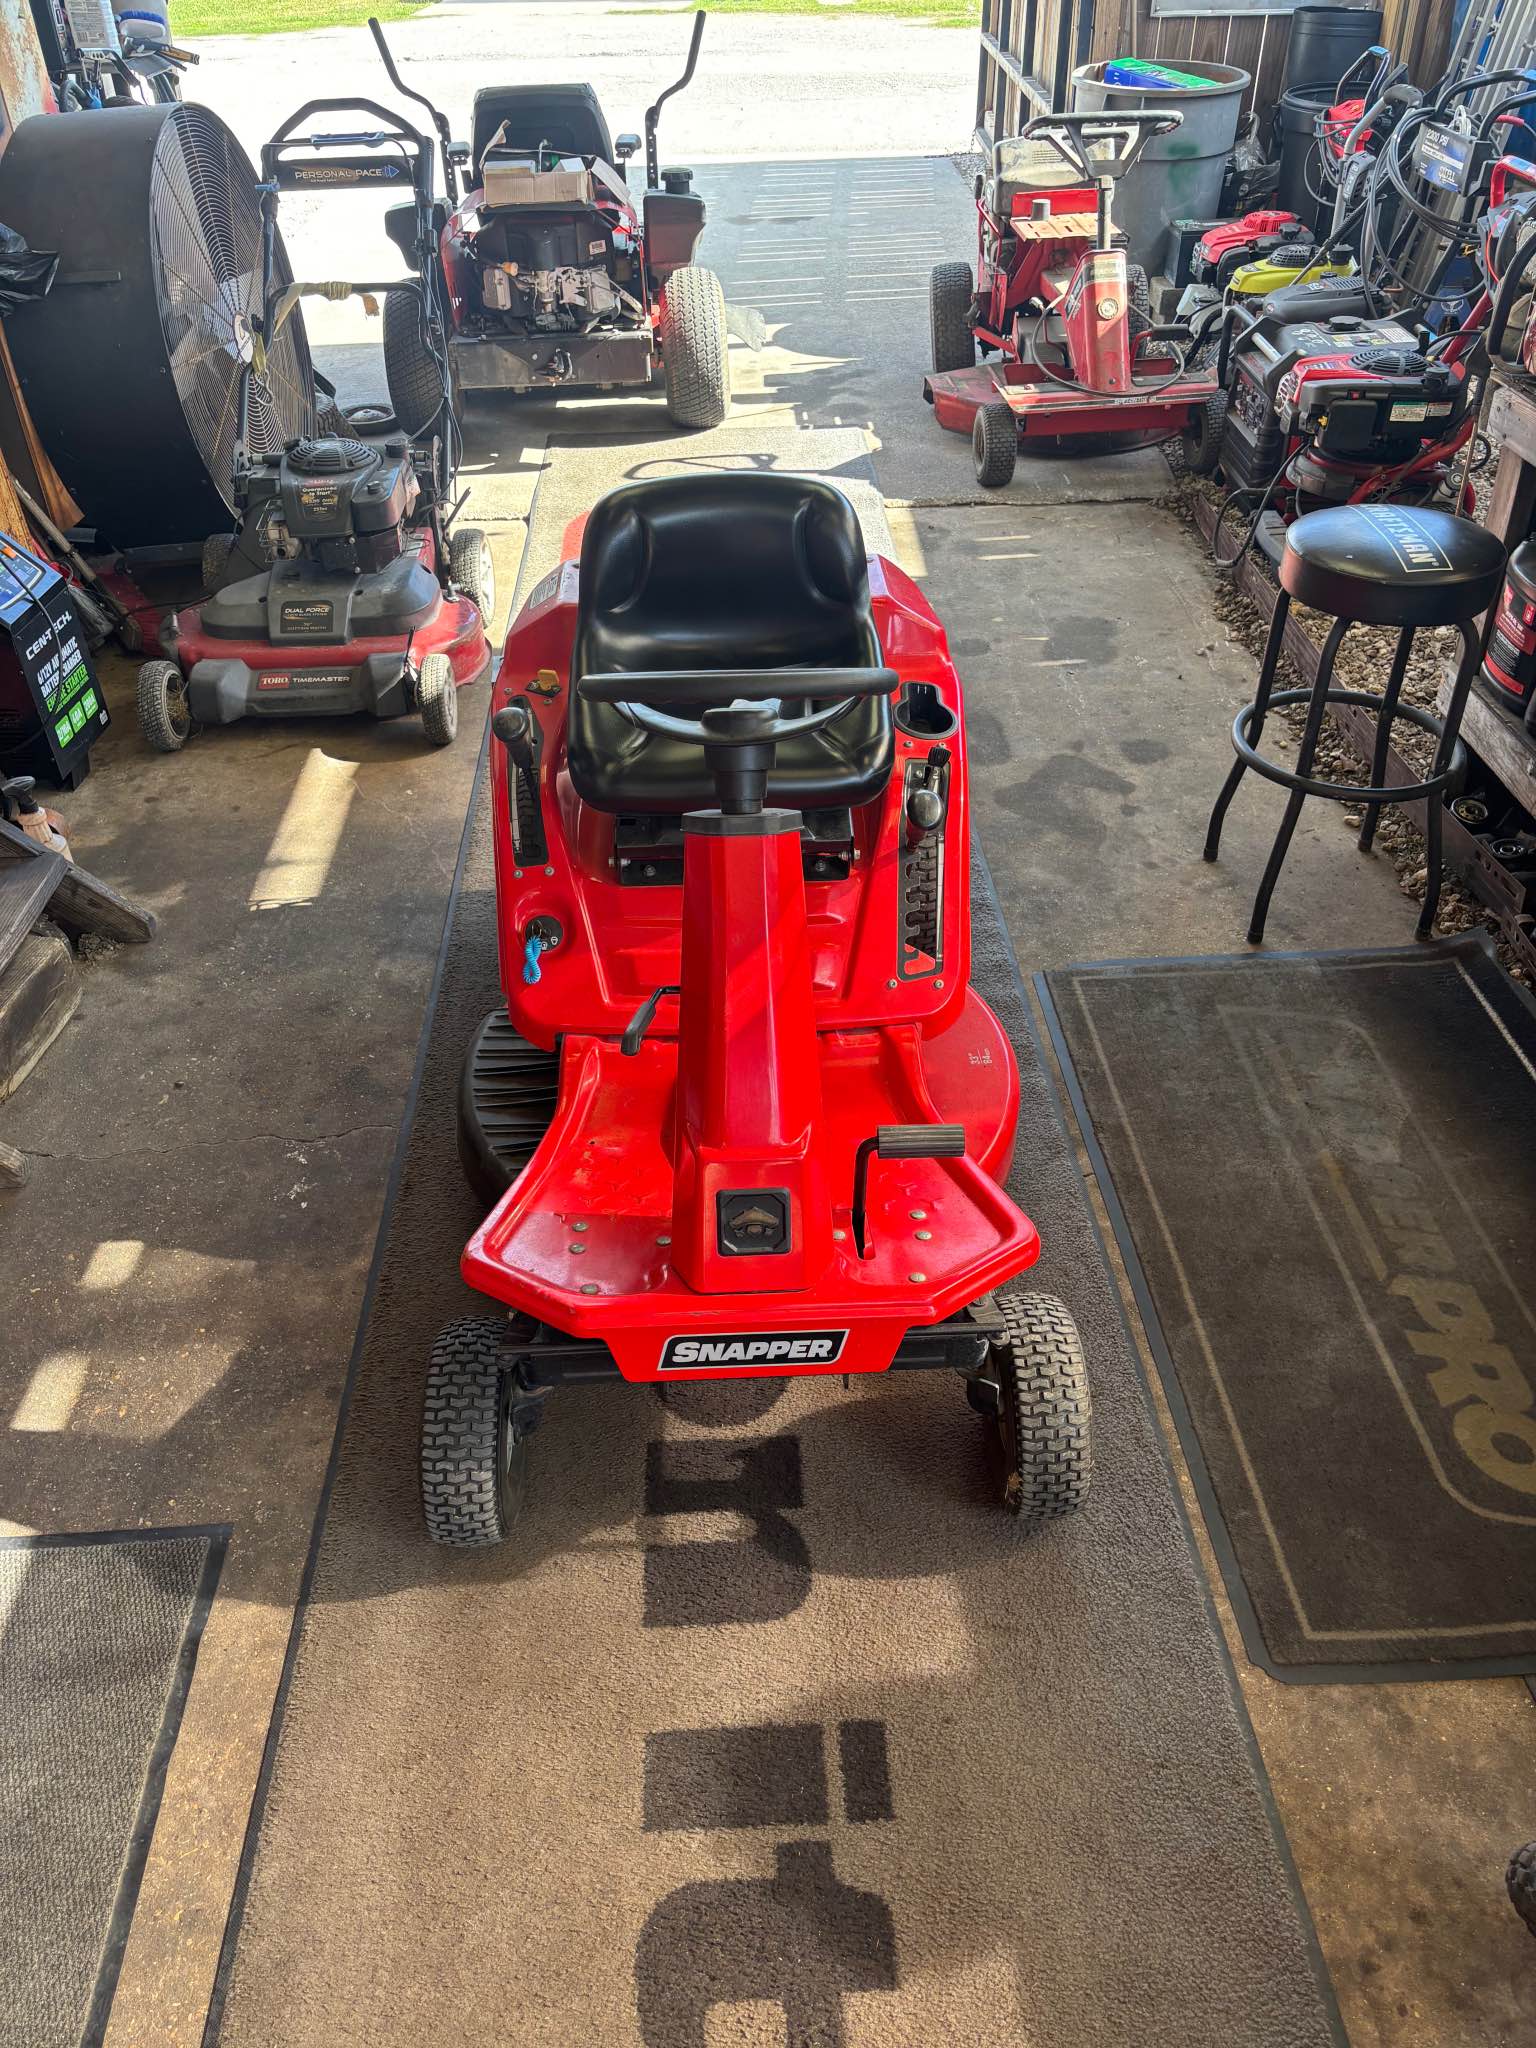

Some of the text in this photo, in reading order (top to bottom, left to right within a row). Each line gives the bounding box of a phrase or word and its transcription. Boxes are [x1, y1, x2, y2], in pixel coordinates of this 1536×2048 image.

[294, 168, 383, 180] PERSONAL PACE
[262, 677, 288, 685] TORO
[671, 1339, 833, 1363] SNAPPER
